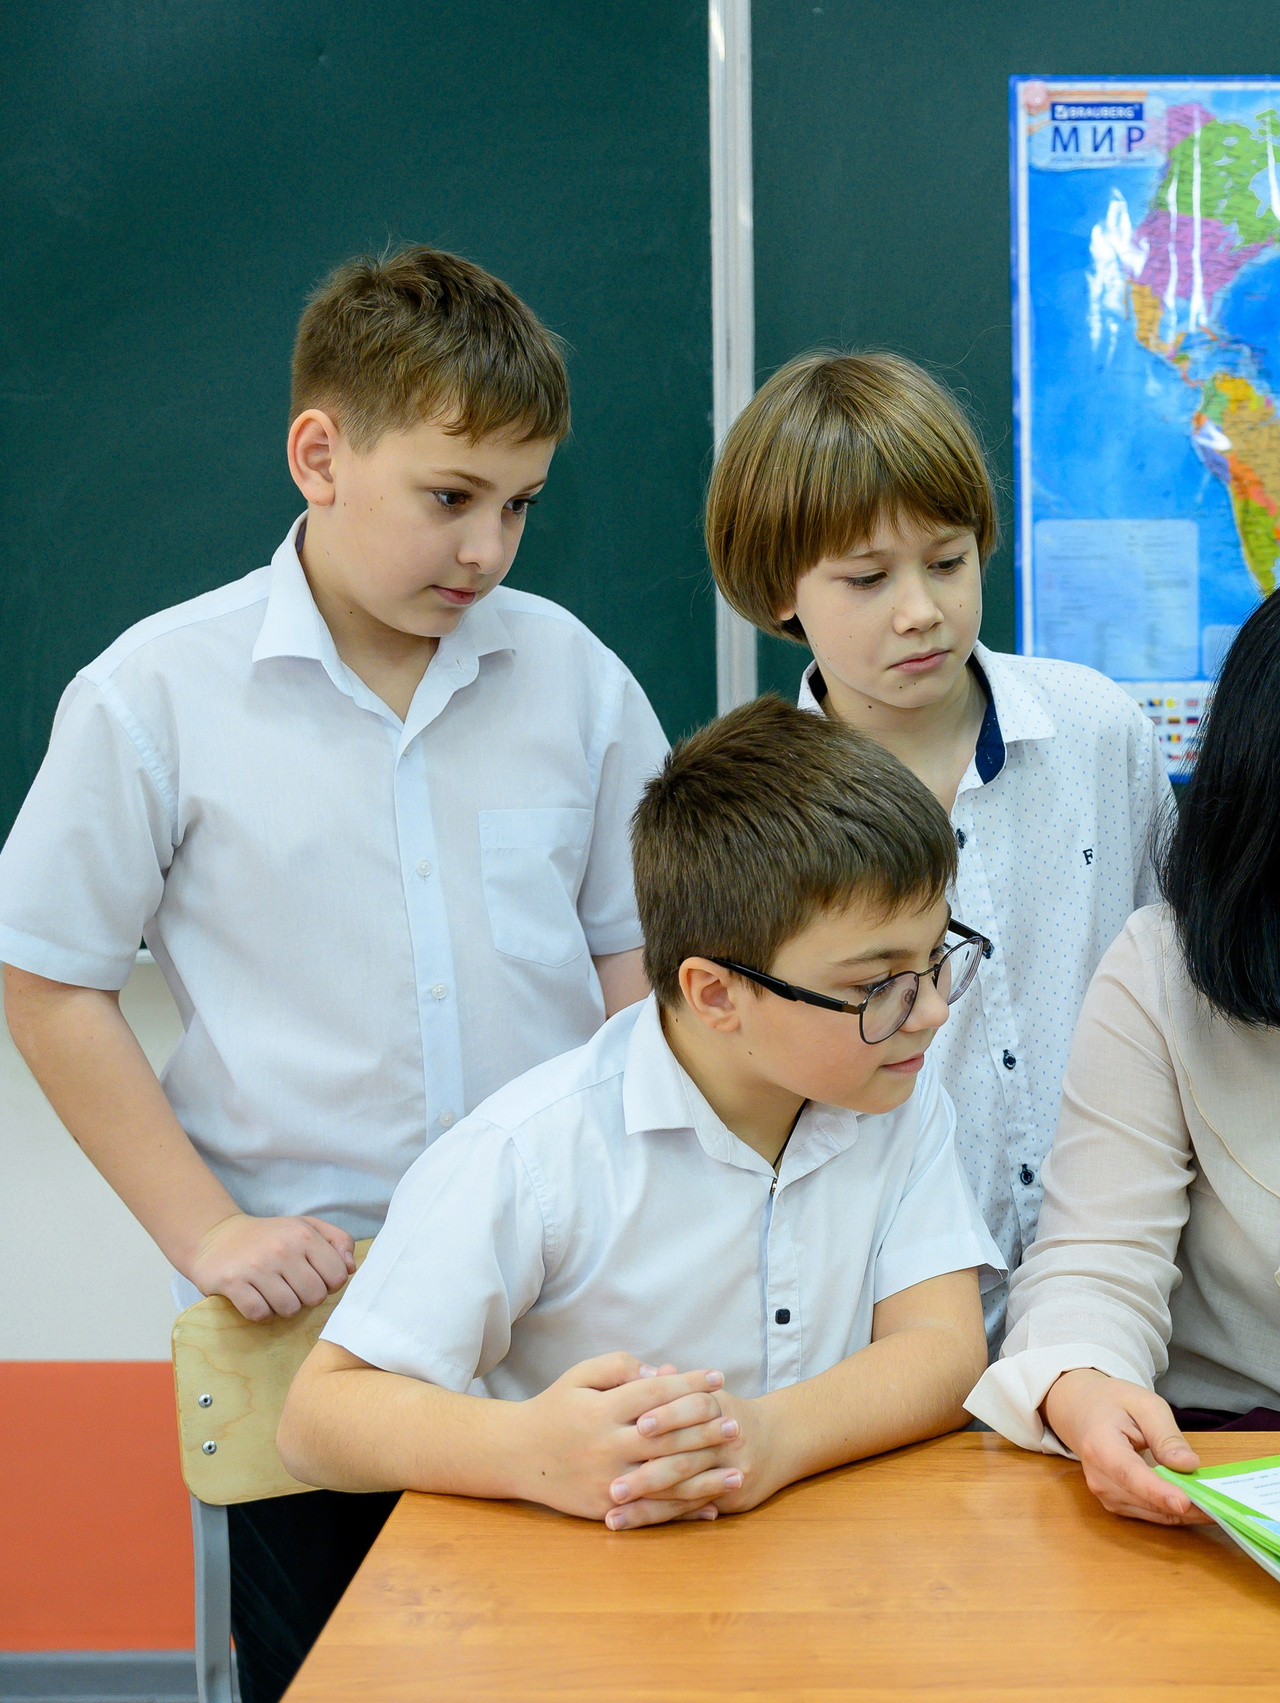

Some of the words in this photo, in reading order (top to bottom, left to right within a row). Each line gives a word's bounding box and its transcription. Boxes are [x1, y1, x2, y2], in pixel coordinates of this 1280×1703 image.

[1068, 106, 1135, 119] BRAUBERG
[1051, 125, 1145, 153] МИР
[1082, 848, 1094, 866] F
